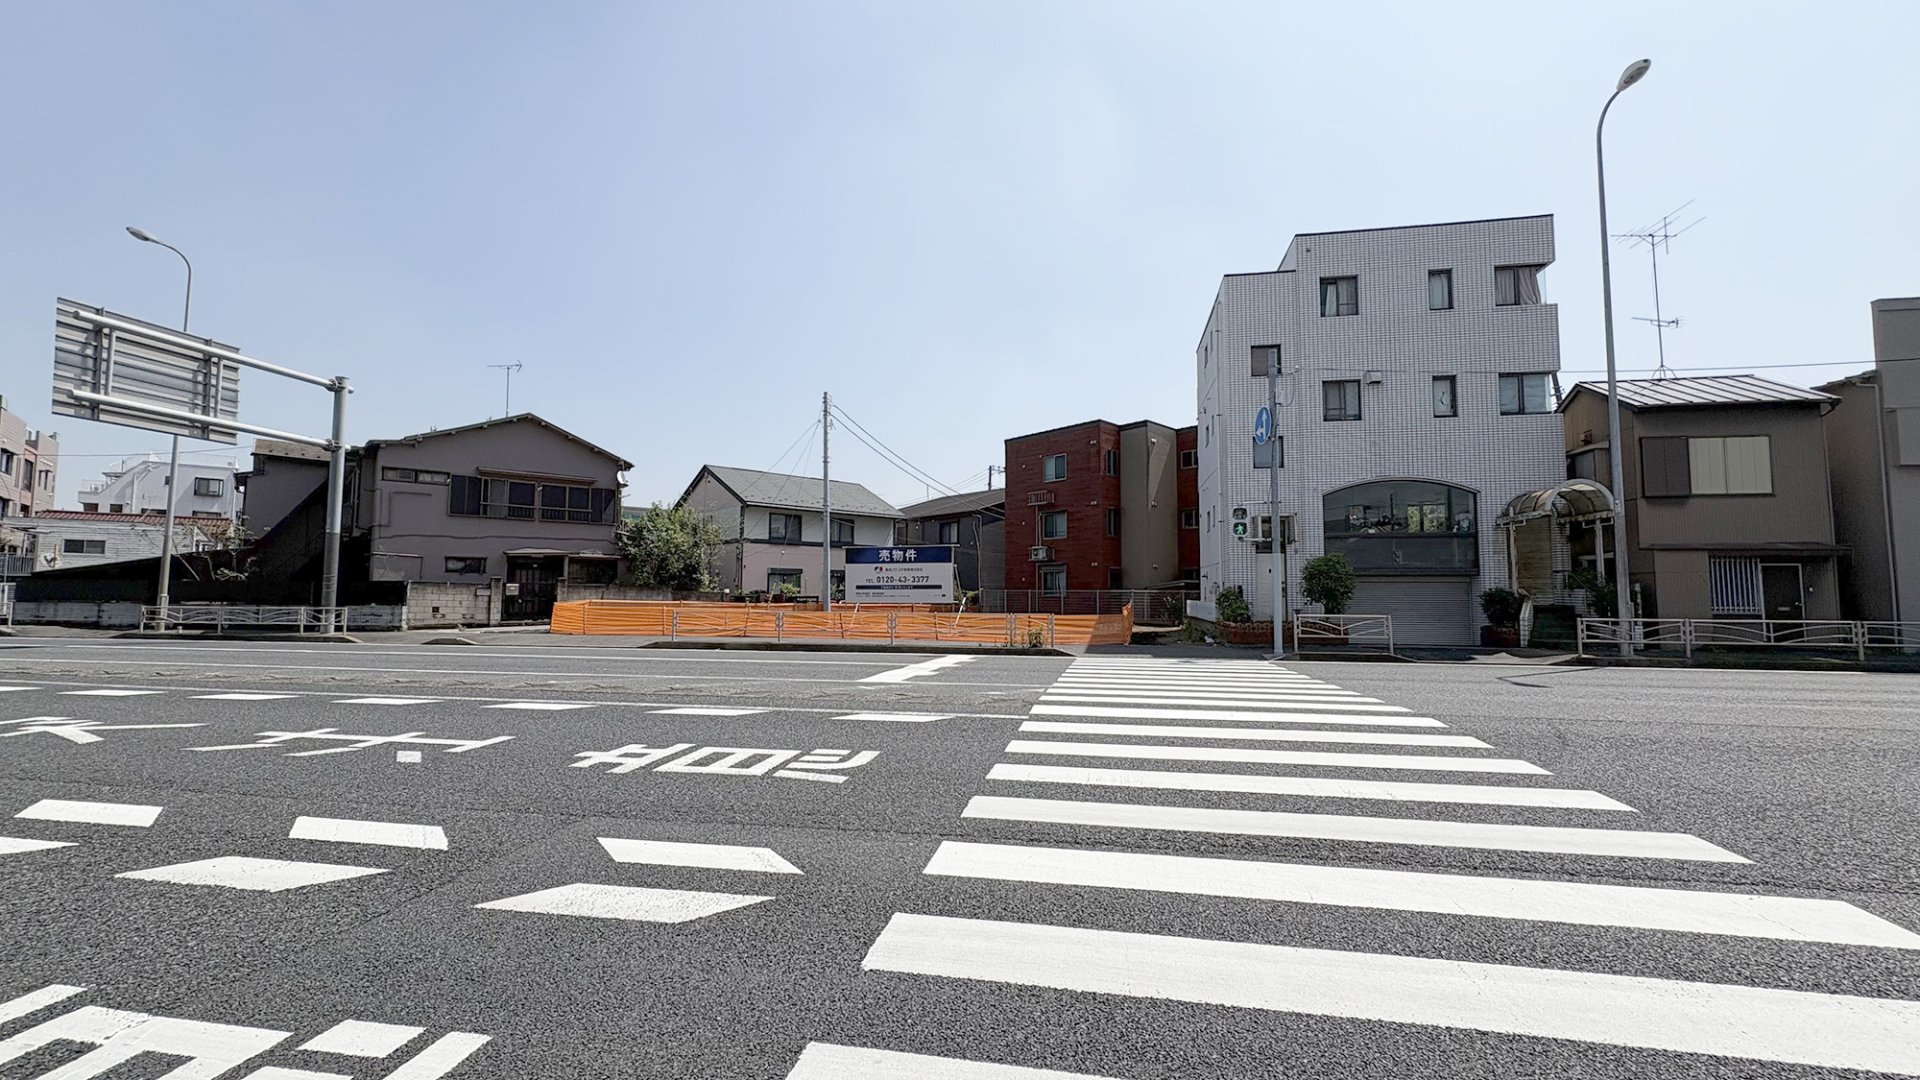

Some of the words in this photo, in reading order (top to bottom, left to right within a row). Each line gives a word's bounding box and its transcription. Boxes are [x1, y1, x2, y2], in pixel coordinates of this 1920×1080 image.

[878, 549, 918, 562] 売物件
[876, 575, 930, 584] 0120-43-3377
